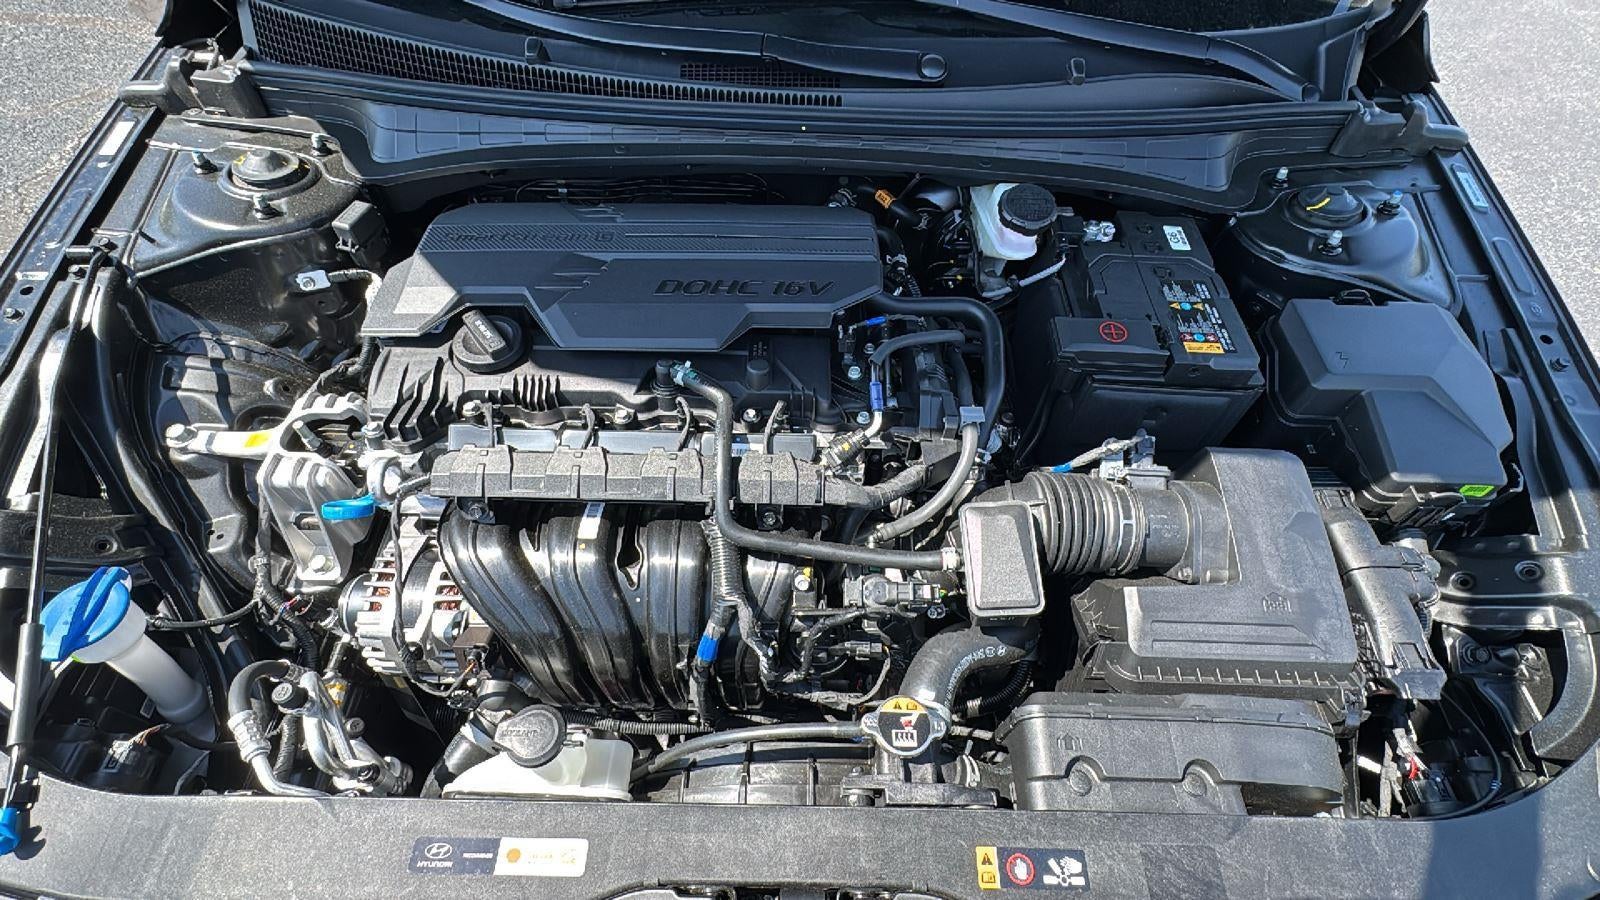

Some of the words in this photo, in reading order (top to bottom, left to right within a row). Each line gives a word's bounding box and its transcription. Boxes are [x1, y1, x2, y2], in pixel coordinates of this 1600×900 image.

[653, 279, 764, 296] DOHC
[771, 280, 835, 296] 16V
[416, 860, 453, 868] HYUNDAI
